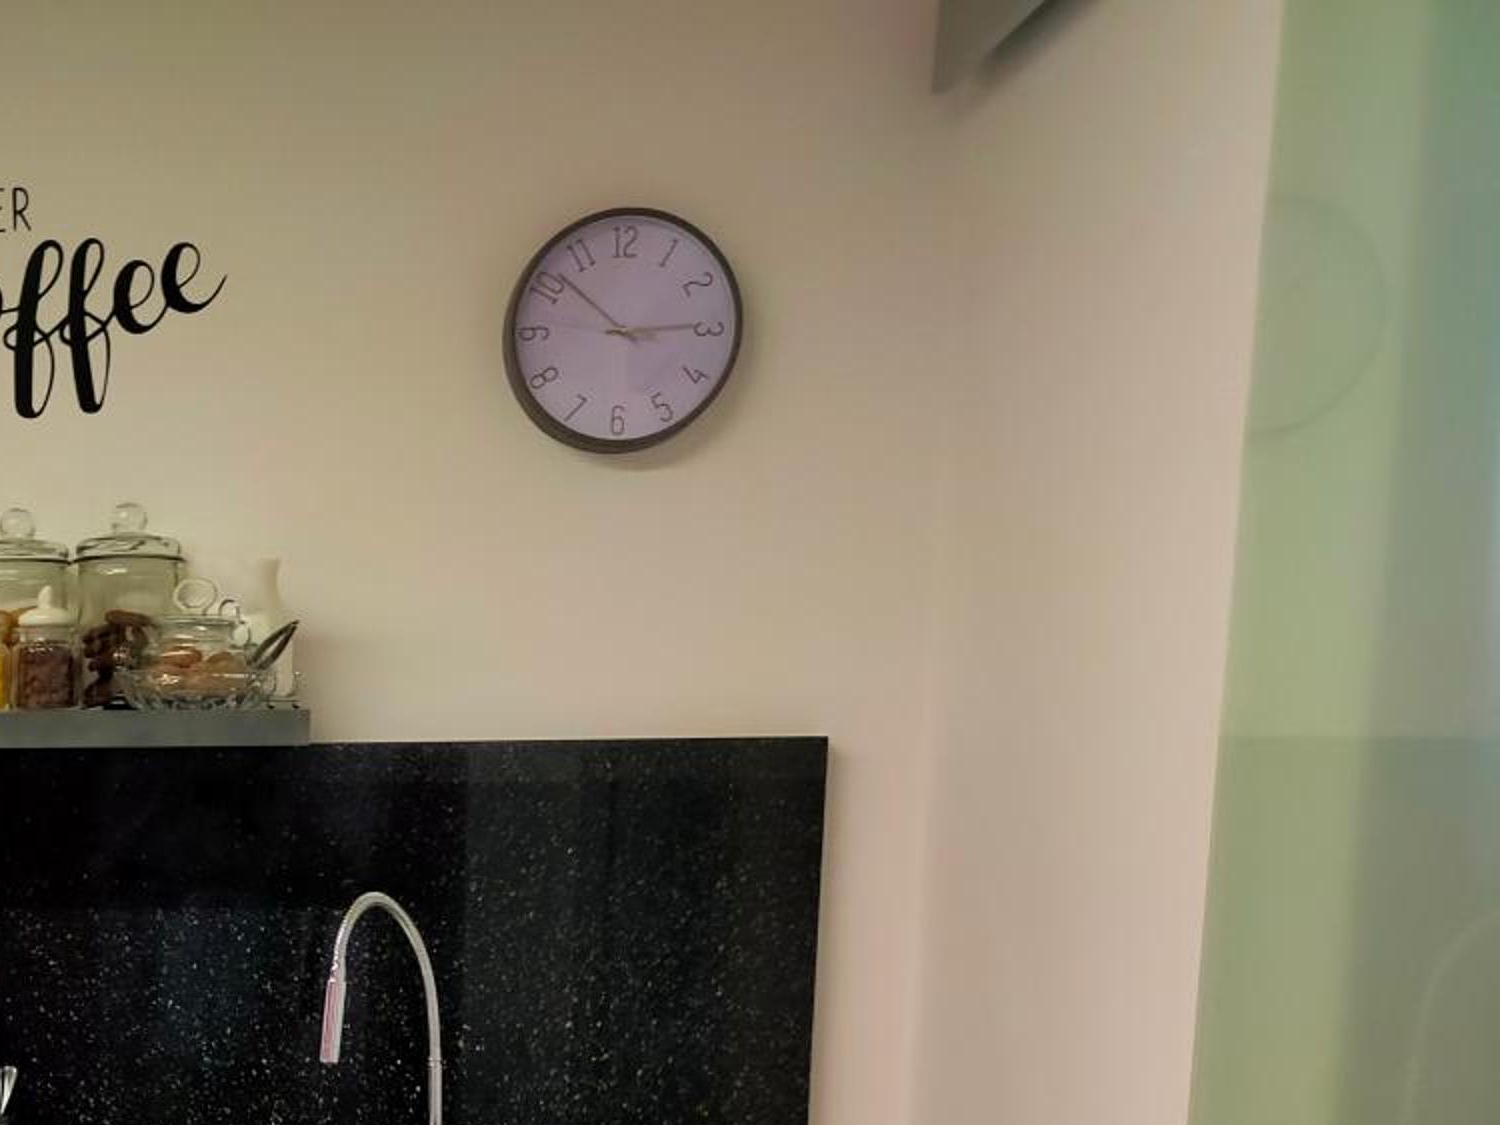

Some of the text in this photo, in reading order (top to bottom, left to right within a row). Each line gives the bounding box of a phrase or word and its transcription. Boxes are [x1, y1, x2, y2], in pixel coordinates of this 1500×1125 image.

[566, 238, 597, 273] 11
[611, 225, 639, 259] 12
[658, 238, 680, 269] 1
[530, 270, 566, 306] 10
[681, 271, 714, 298] 2
[516, 325, 550, 342] 9
[692, 321, 725, 338] 3
[529, 366, 560, 390] 8
[682, 364, 710, 385] 4
[563, 393, 588, 423] 7
[609, 404, 626, 436] 6
[650, 391, 674, 423] 5
